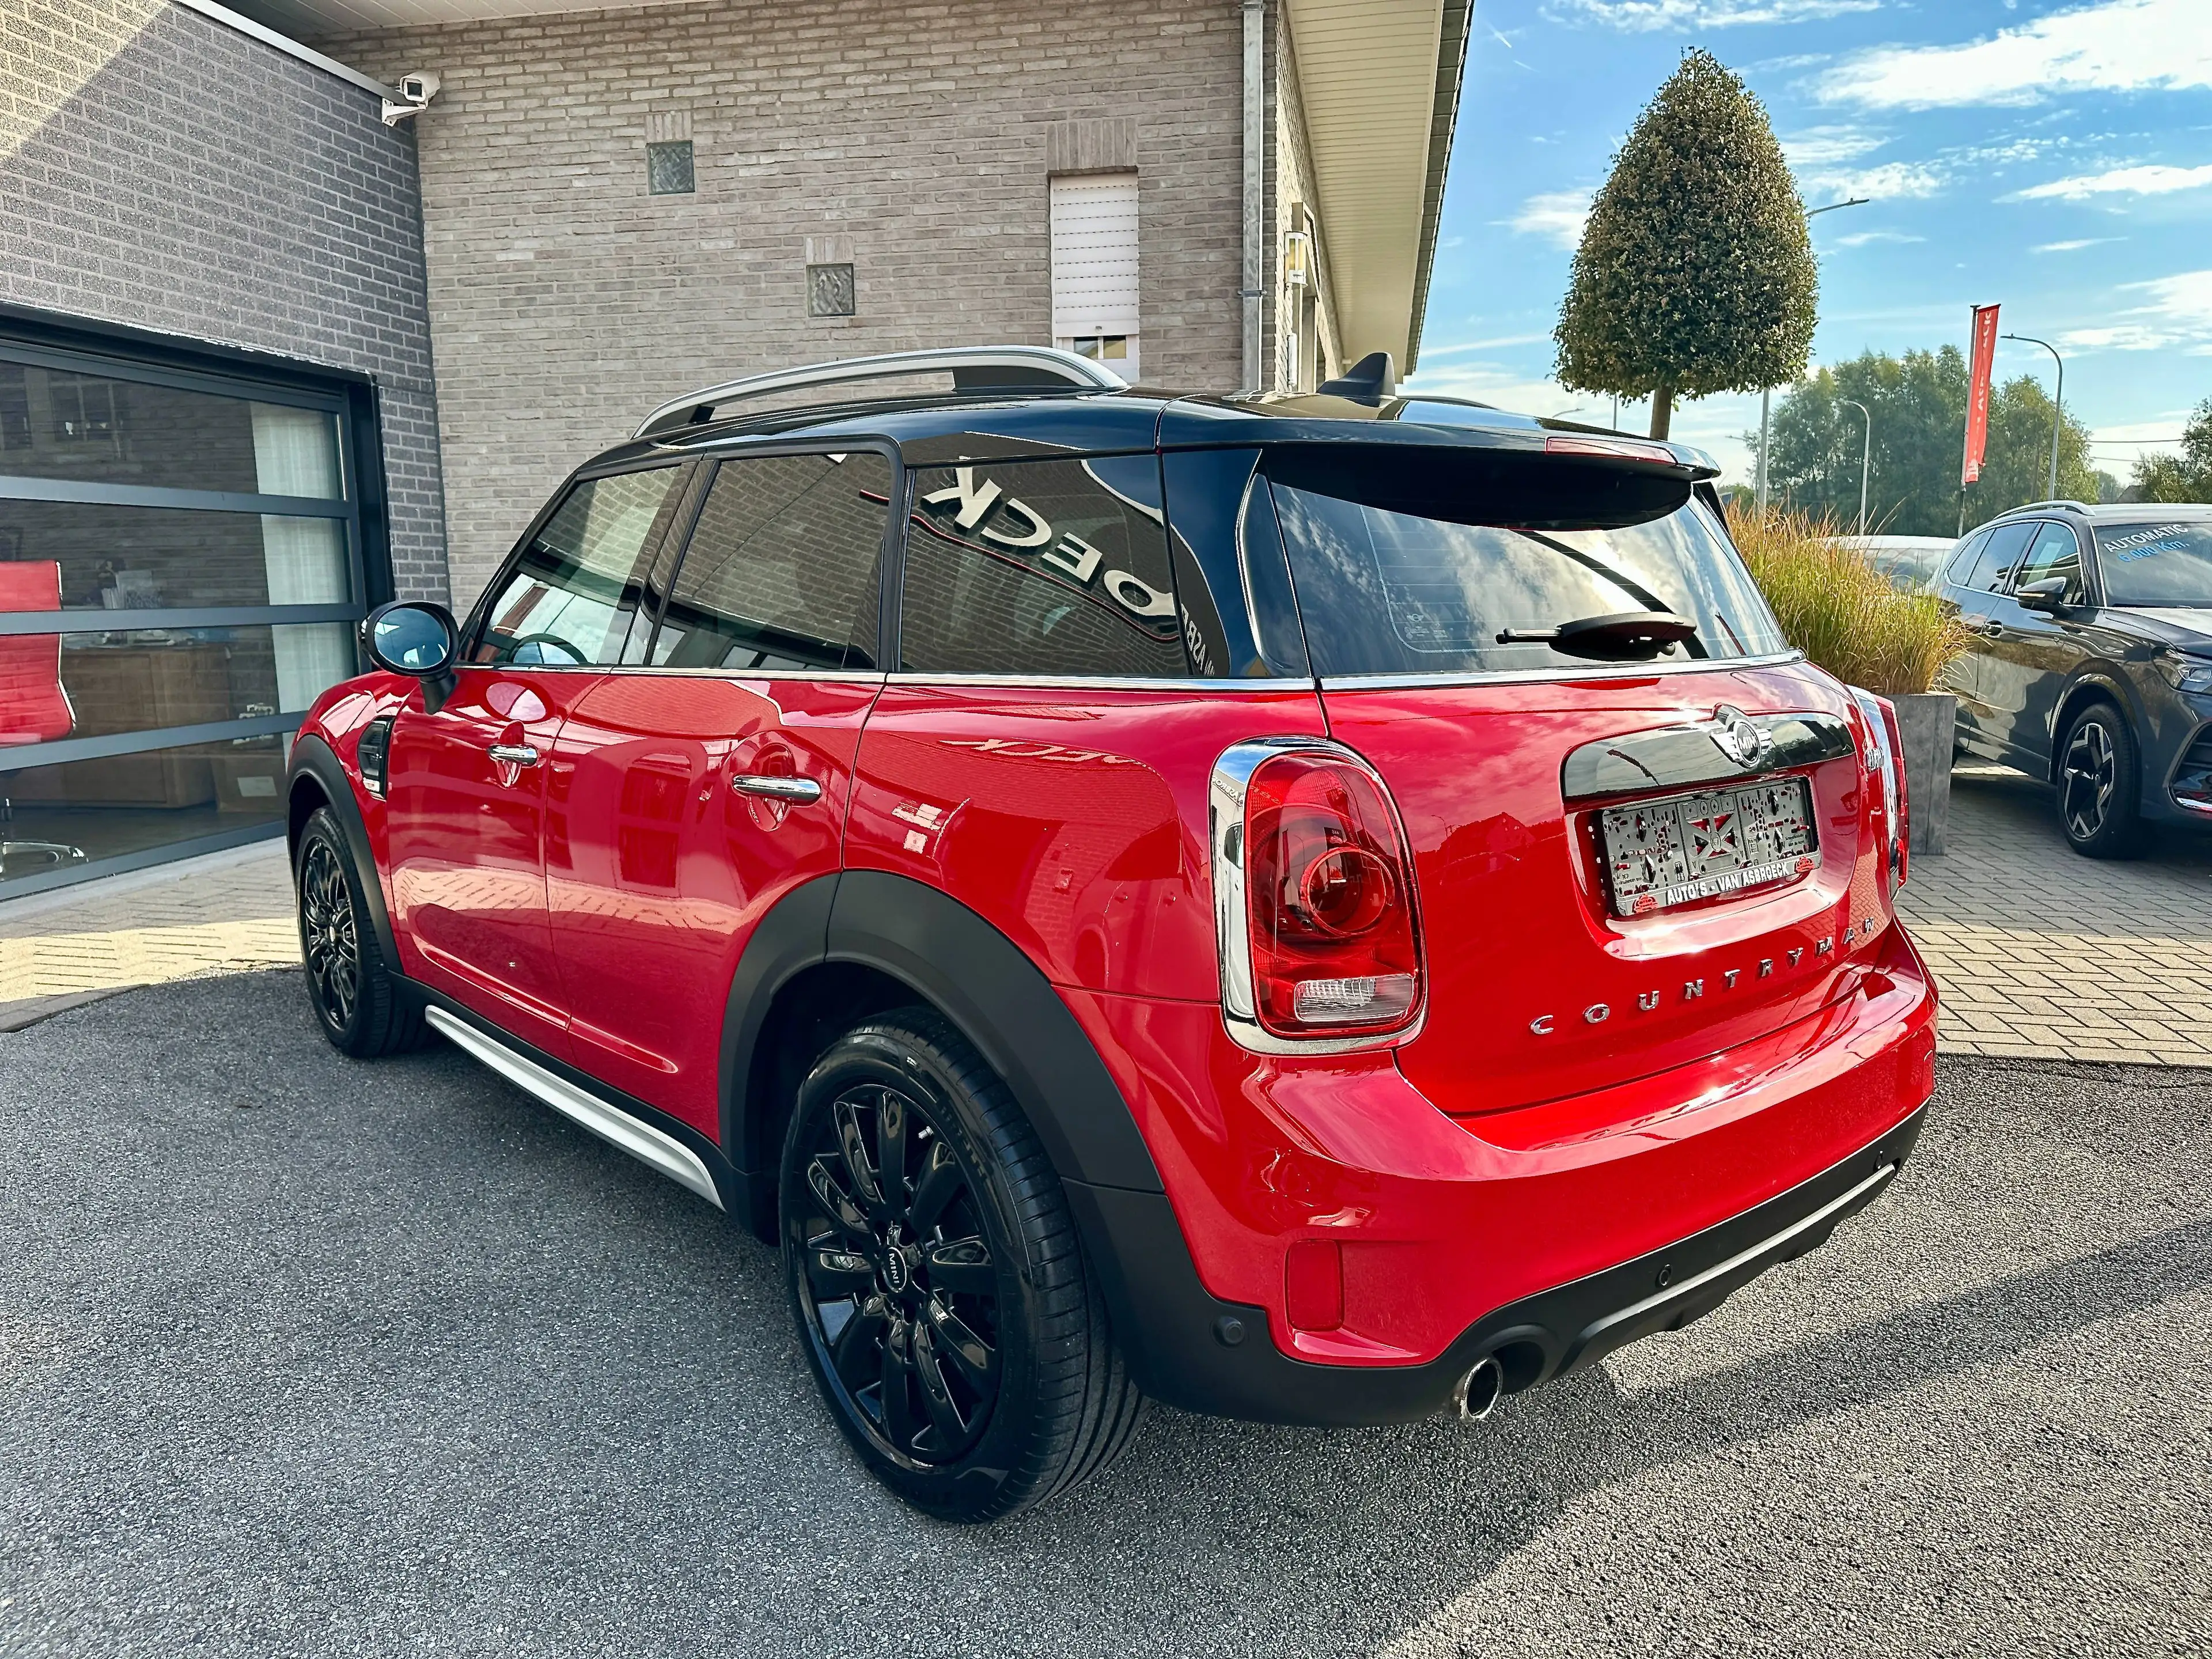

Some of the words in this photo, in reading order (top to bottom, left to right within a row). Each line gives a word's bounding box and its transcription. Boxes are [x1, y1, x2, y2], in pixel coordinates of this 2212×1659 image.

[2104, 524, 2188, 552] AUTOMATIC
[1667, 882, 1706, 905] AUTO'S
[1717, 873, 1740, 891] VAN
[1741, 862, 1789, 886] ASBROECK
[1529, 917, 1875, 1035] COUNTRYMAN
[889, 1253, 900, 1284] MINI
